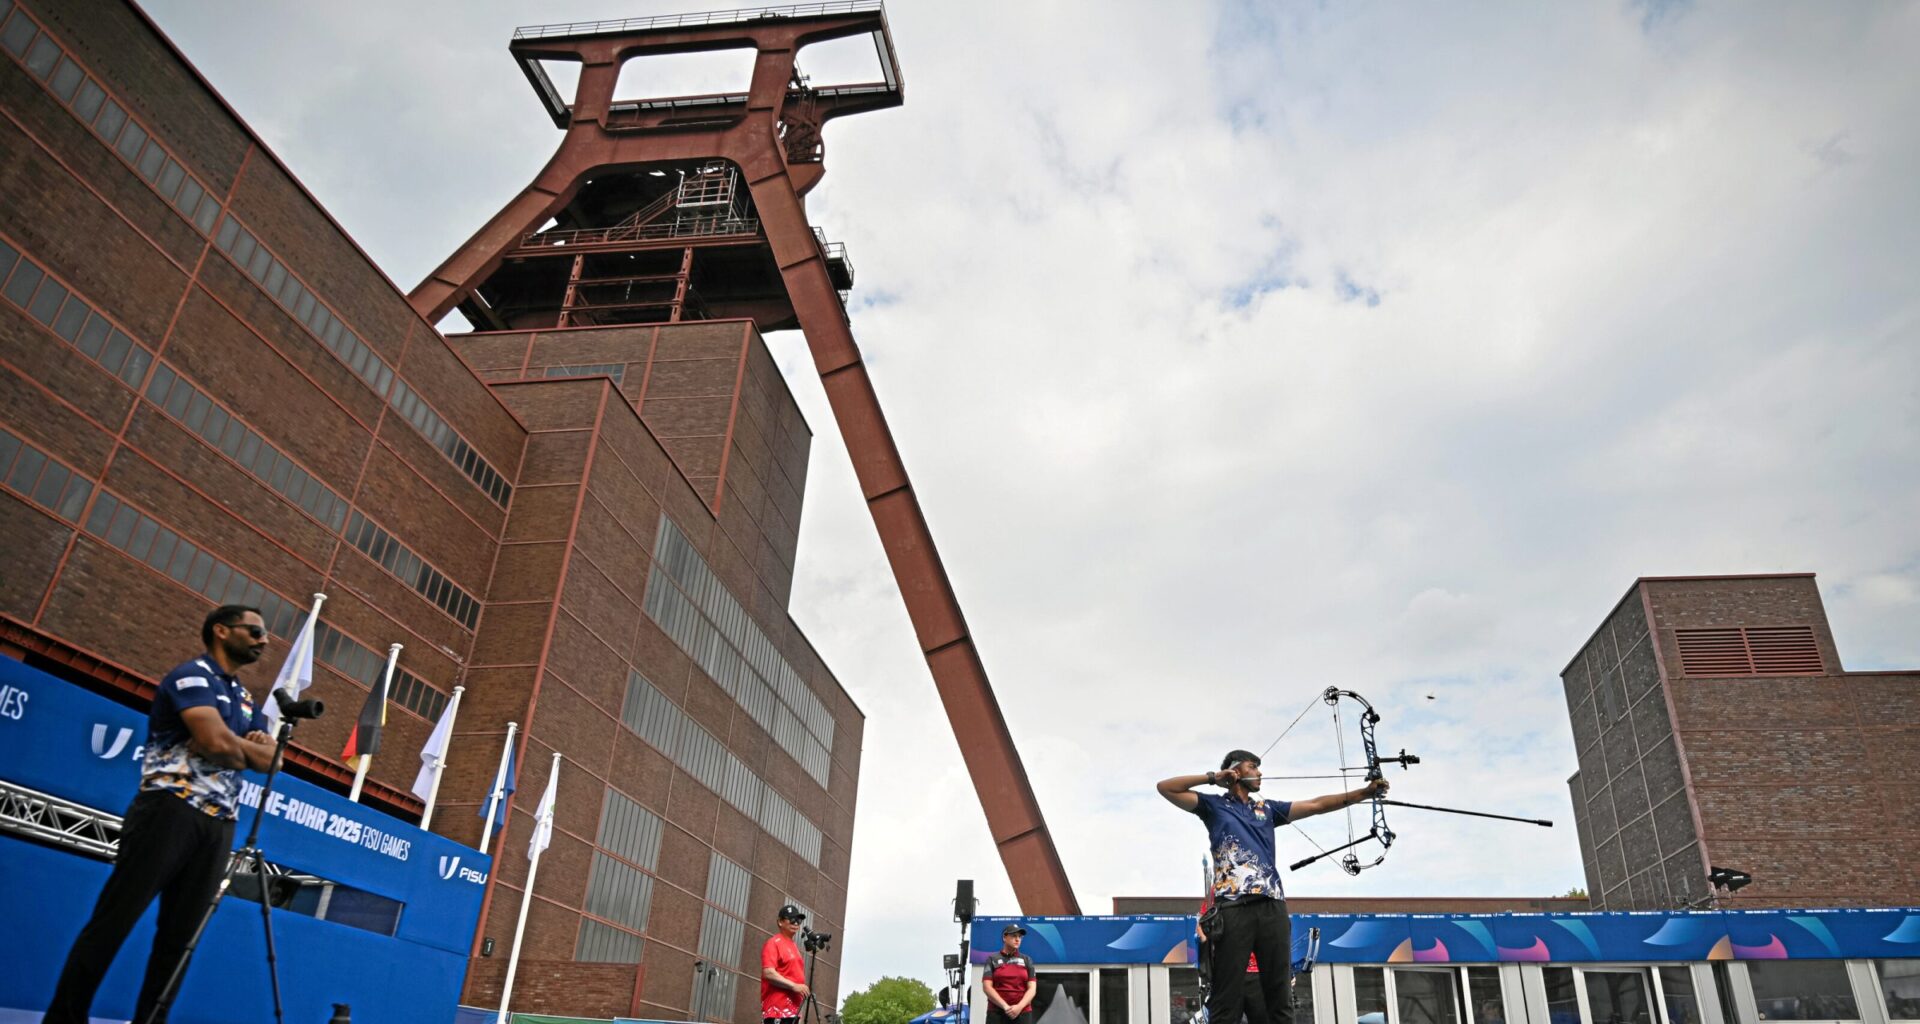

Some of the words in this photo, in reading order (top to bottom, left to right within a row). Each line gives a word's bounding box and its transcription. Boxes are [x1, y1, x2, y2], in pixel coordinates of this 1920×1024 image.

[325, 814, 363, 844] 2025
[360, 825, 383, 851] FISU
[381, 833, 411, 861] GAMES
[459, 867, 488, 885] FISU
